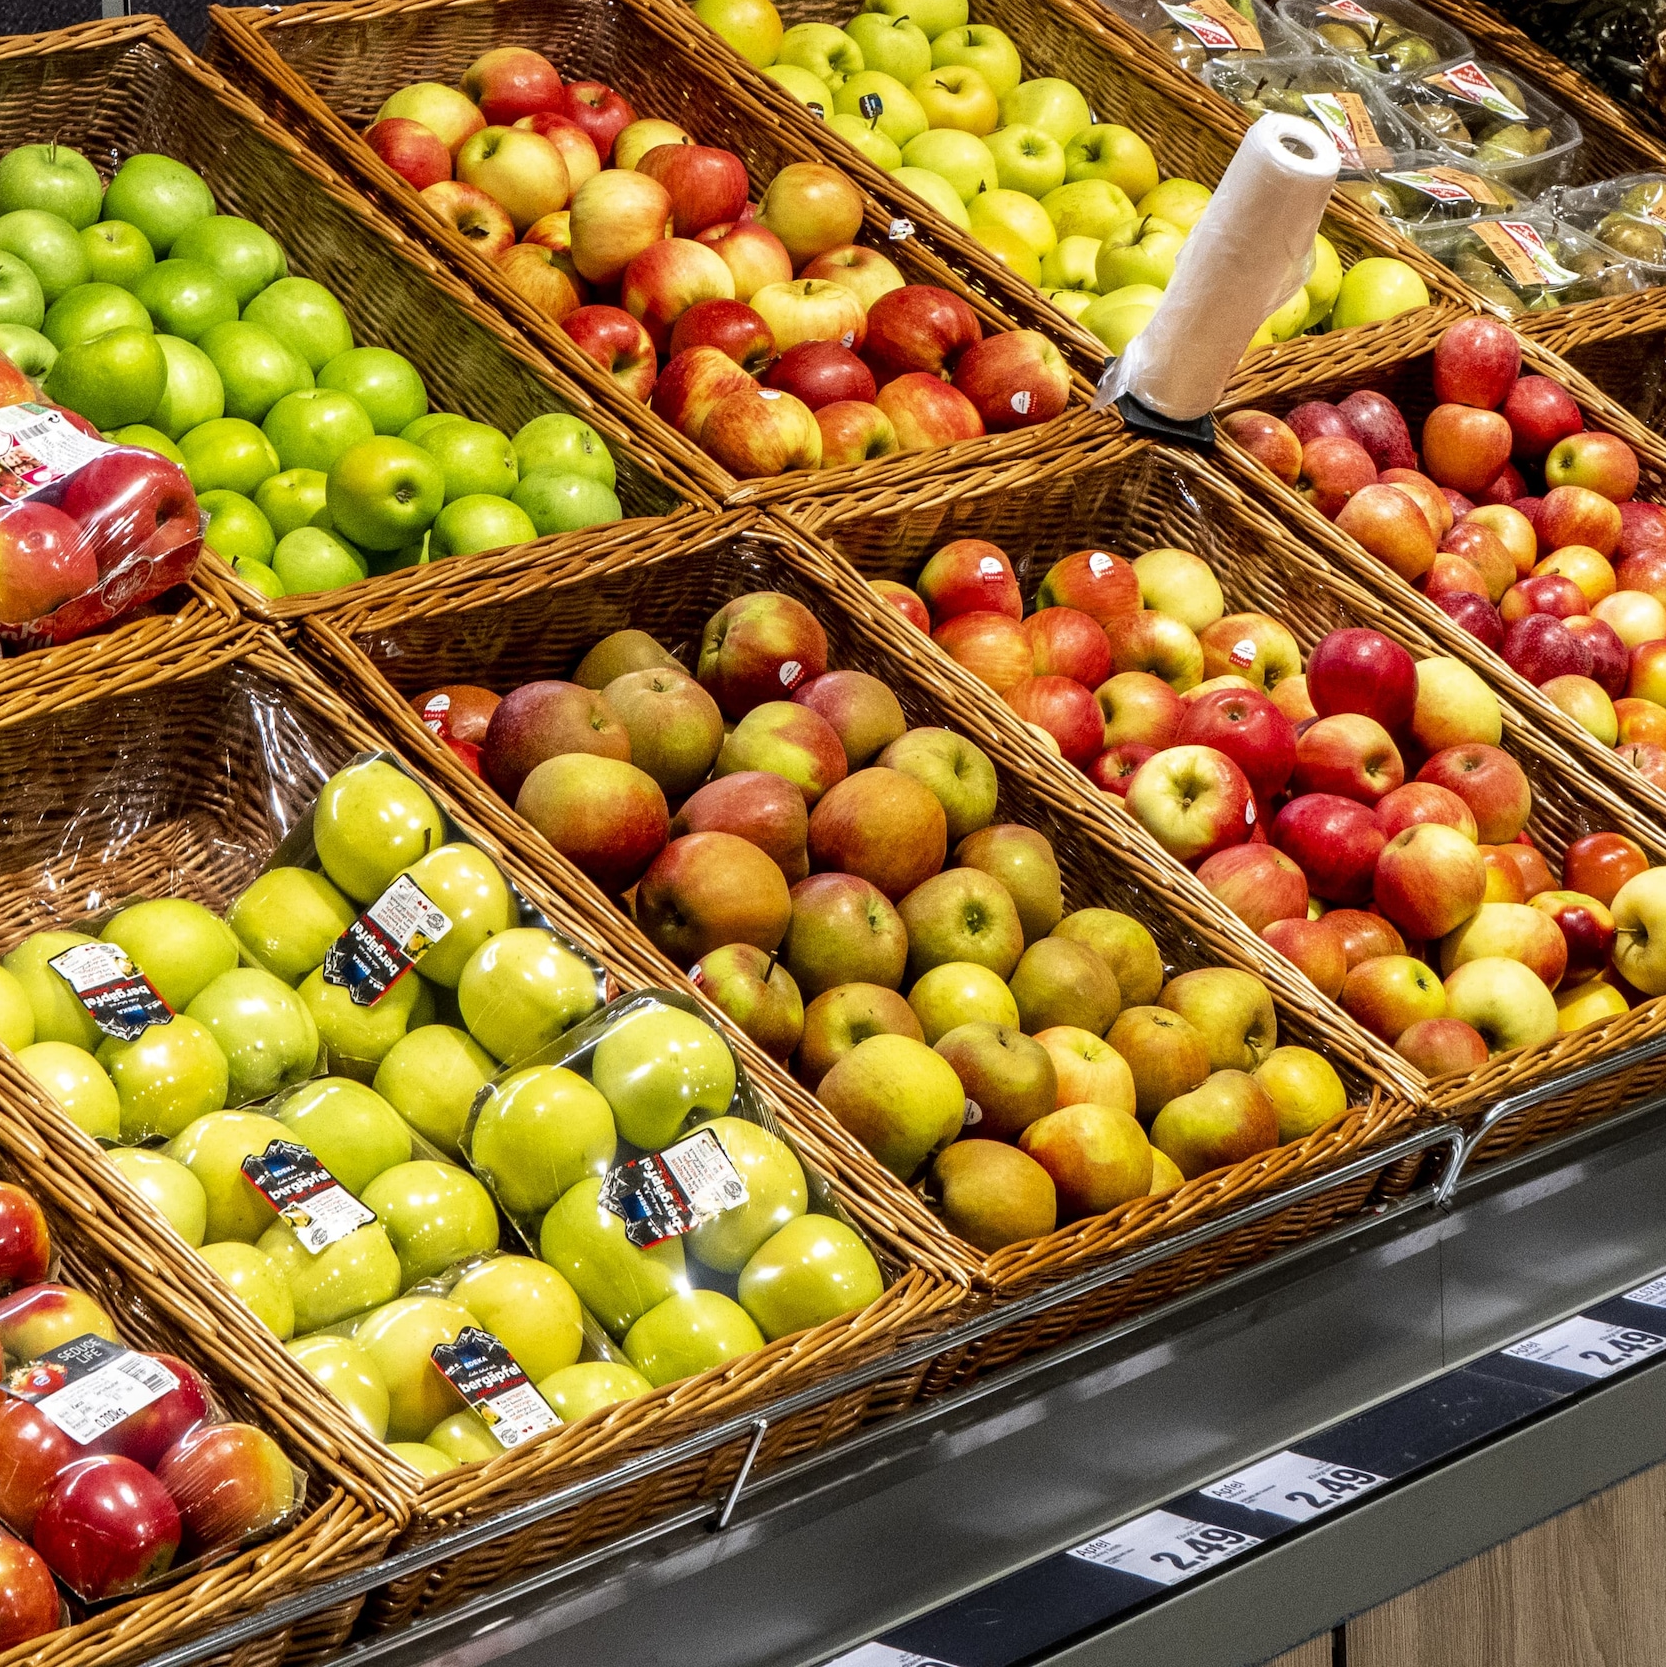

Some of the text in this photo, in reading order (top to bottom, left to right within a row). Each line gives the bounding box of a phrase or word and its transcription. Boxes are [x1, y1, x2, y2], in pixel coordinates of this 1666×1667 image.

[348, 919, 401, 977] bergäpfel
[351, 954, 371, 976] EDEKA
[83, 981, 152, 1010] bergäpfel
[116, 1003, 143, 1016] EDEKA
[267, 1168, 332, 1201] bergäpfel
[638, 1156, 686, 1235] bergäpfel
[57, 1337, 103, 1363] SEDUCE
[75, 1347, 103, 1365] LIFE
[1509, 1341, 1540, 1356] Apfel
[1578, 1331, 1664, 1367] 2.49
[458, 1361, 522, 1394] bergäpfel
[1211, 1481, 1246, 1499] Apfel
[1284, 1469, 1377, 1509] 2.49
[1075, 1539, 1111, 1558] Apfel
[1150, 1528, 1247, 1571] 2.49
